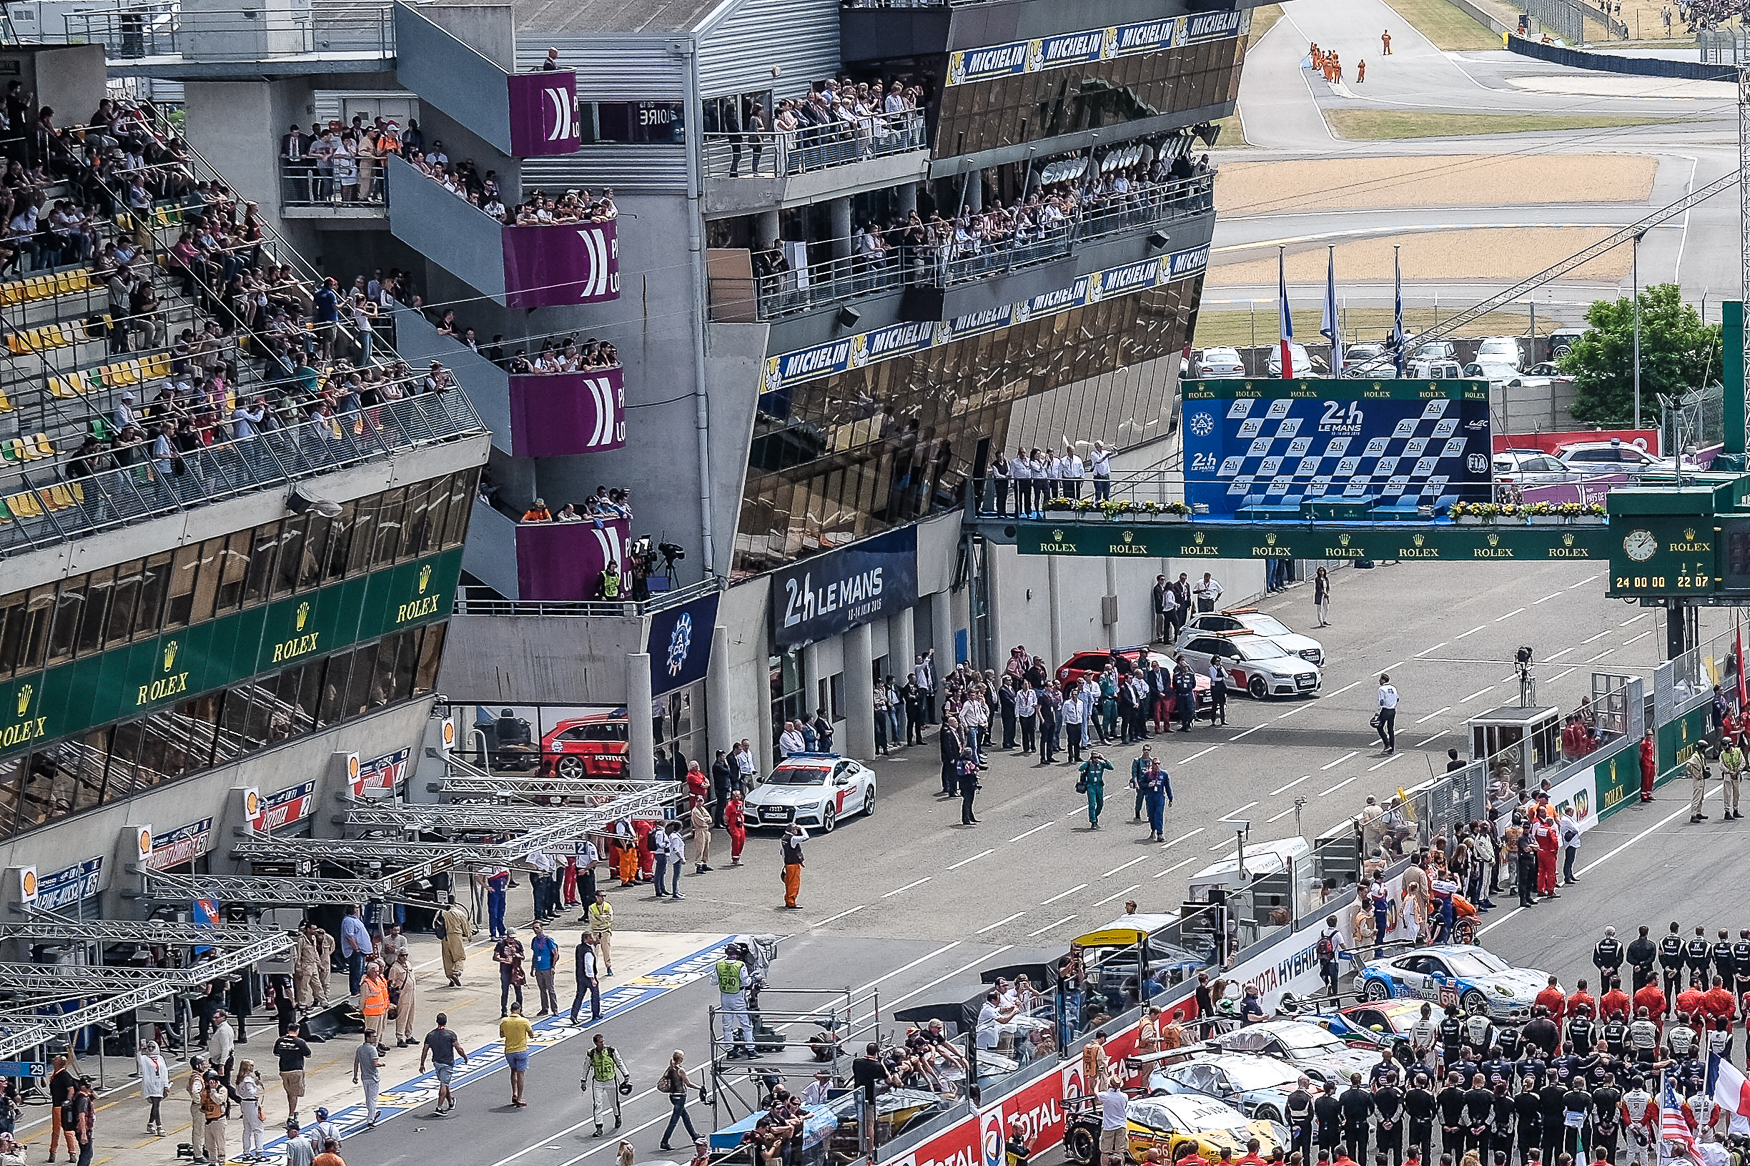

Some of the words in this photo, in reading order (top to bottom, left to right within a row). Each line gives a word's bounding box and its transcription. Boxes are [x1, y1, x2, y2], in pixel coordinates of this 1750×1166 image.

[1191, 11, 1240, 36] MICHELIN
[1121, 22, 1174, 48] MICHELIN
[1046, 33, 1102, 59] MICHELIN
[968, 45, 1027, 73] MICHELIN
[1105, 260, 1156, 290] MICHELIN
[1033, 279, 1087, 310] MICHELIN
[871, 321, 933, 351] MICHELIN
[784, 342, 847, 377] MICHELIN
[1188, 391, 1215, 399] ROLEX
[1235, 390, 1262, 398] ROLEX
[1290, 390, 1317, 398] ROLEX
[1364, 390, 1391, 398] ROLEX
[1419, 390, 1446, 398] ROLEX
[1464, 391, 1486, 399] ROLEX
[1319, 400, 1364, 424] 24h
[1040, 543, 1077, 552] ROLEX
[1109, 544, 1147, 554] ROLEX
[1180, 546, 1219, 555] ROLEX
[1252, 547, 1291, 556] ROLEX
[1325, 548, 1364, 557] ROLEX
[1399, 548, 1439, 557] ROLEX
[1474, 548, 1514, 557] ROLEX
[1549, 548, 1589, 557] ROLEX
[1669, 543, 1710, 551] ROLEX
[1617, 577, 1630, 587] 24
[1634, 577, 1648, 587] 00
[1652, 577, 1665, 587] 00
[1678, 577, 1691, 587] 22
[784, 572, 814, 628] 24h
[818, 583, 837, 615] LE
[839, 567, 882, 608] MANS
[396, 593, 440, 623] ROLEX
[272, 632, 319, 663] ROLEX
[136, 672, 189, 706] ROLEX
[576, 842, 586, 854] 2
[302, 862, 311, 874] 50
[423, 864, 432, 876] 50
[384, 880, 393, 892] 50
[29, 1063, 44, 1076] 29
[1007, 1098, 1062, 1142] TOTAL
